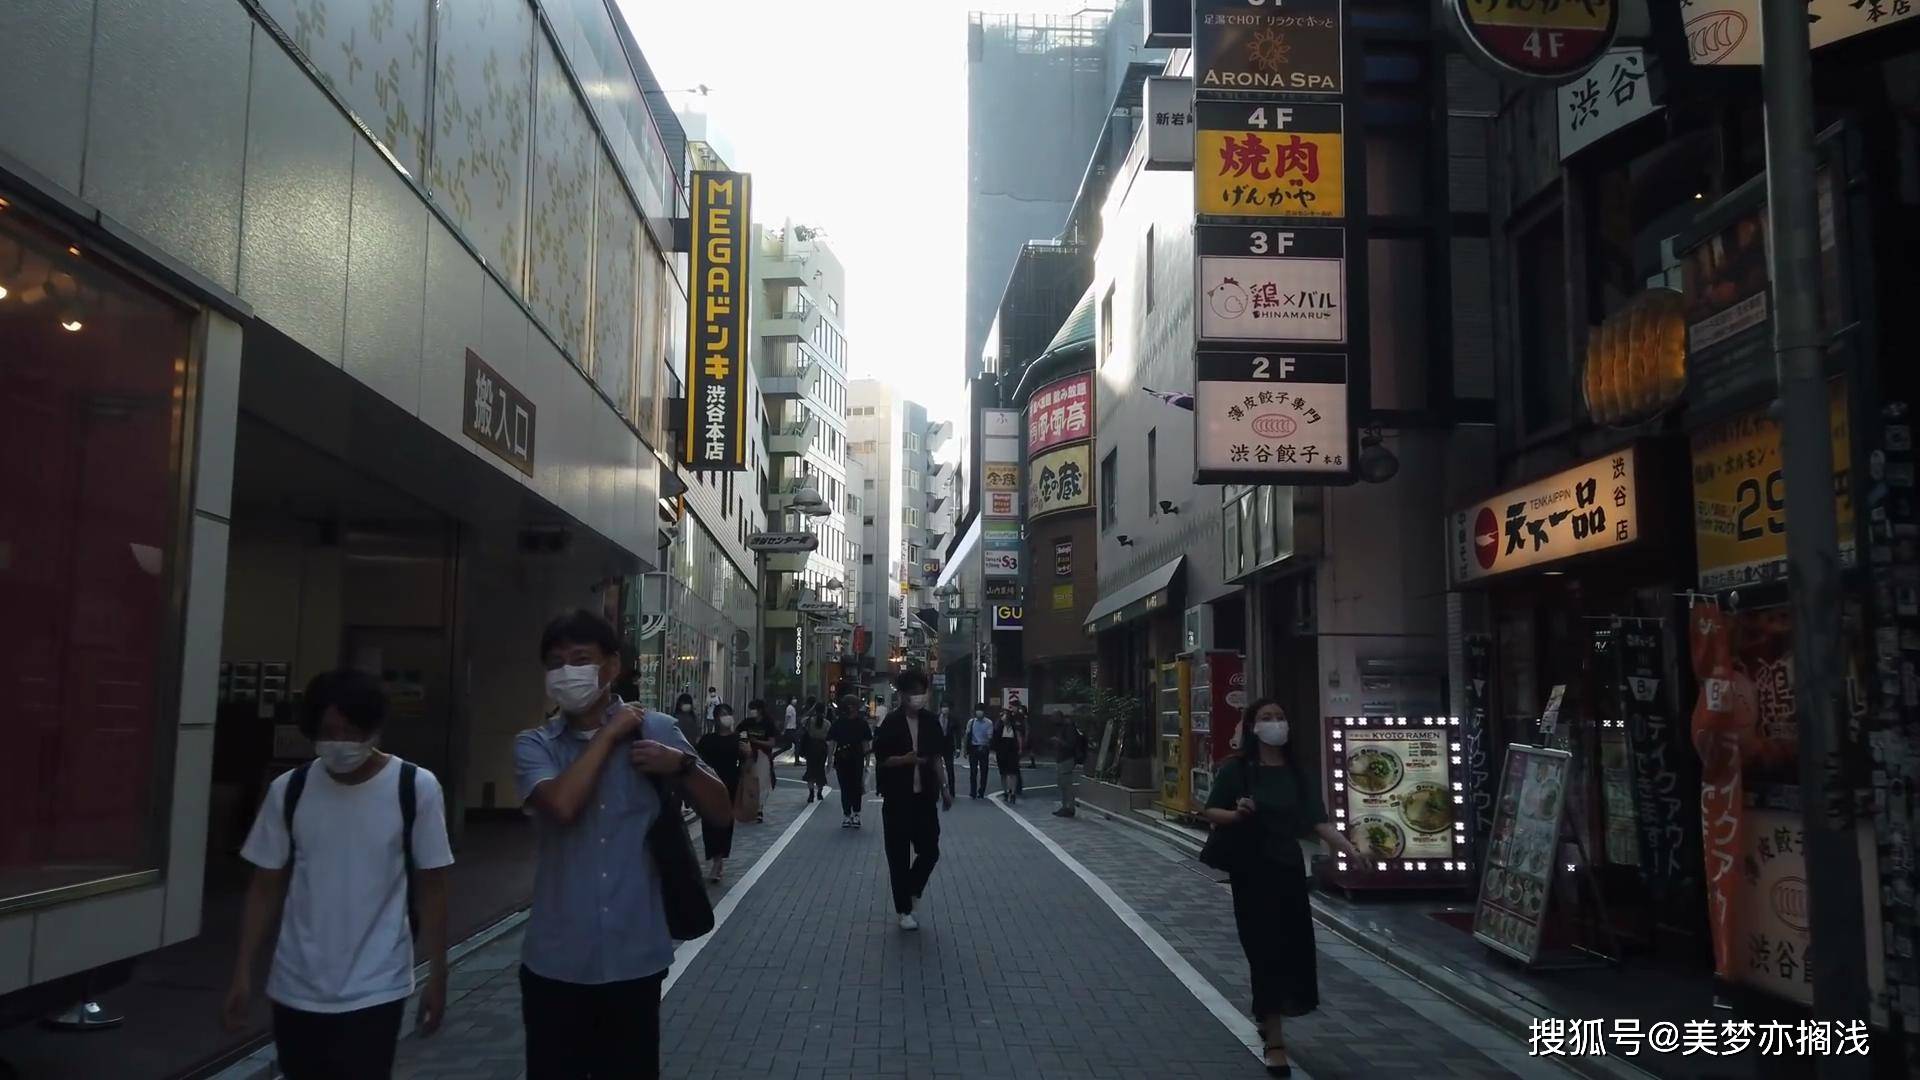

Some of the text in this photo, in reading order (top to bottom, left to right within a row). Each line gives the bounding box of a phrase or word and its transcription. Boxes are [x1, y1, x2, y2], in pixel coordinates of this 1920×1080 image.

[1522, 31, 1566, 59] 4F
[1204, 69, 1285, 88] ARONA
[1569, 56, 1644, 131] 渋谷
[1248, 107, 1294, 129] 4F
[1218, 133, 1320, 183] 焼肉
[1249, 231, 1295, 255] 3F
[1252, 356, 1296, 380] 2F
[474, 368, 529, 462] 搬入口
[704, 384, 726, 462] 渋谷本店
[1230, 443, 1343, 466] 渋谷餃子 本店
[1039, 461, 1082, 502] 金の蔵
[1529, 487, 1571, 512] TENKAIPPIN
[1612, 456, 1629, 542] 渋谷店
[1504, 477, 1606, 556] 天下一品
[922, 562, 940, 572] GU
[998, 606, 1023, 620] GU
[1372, 731, 1405, 740] KYOTO
[1406, 731, 1440, 740] RAMEN
